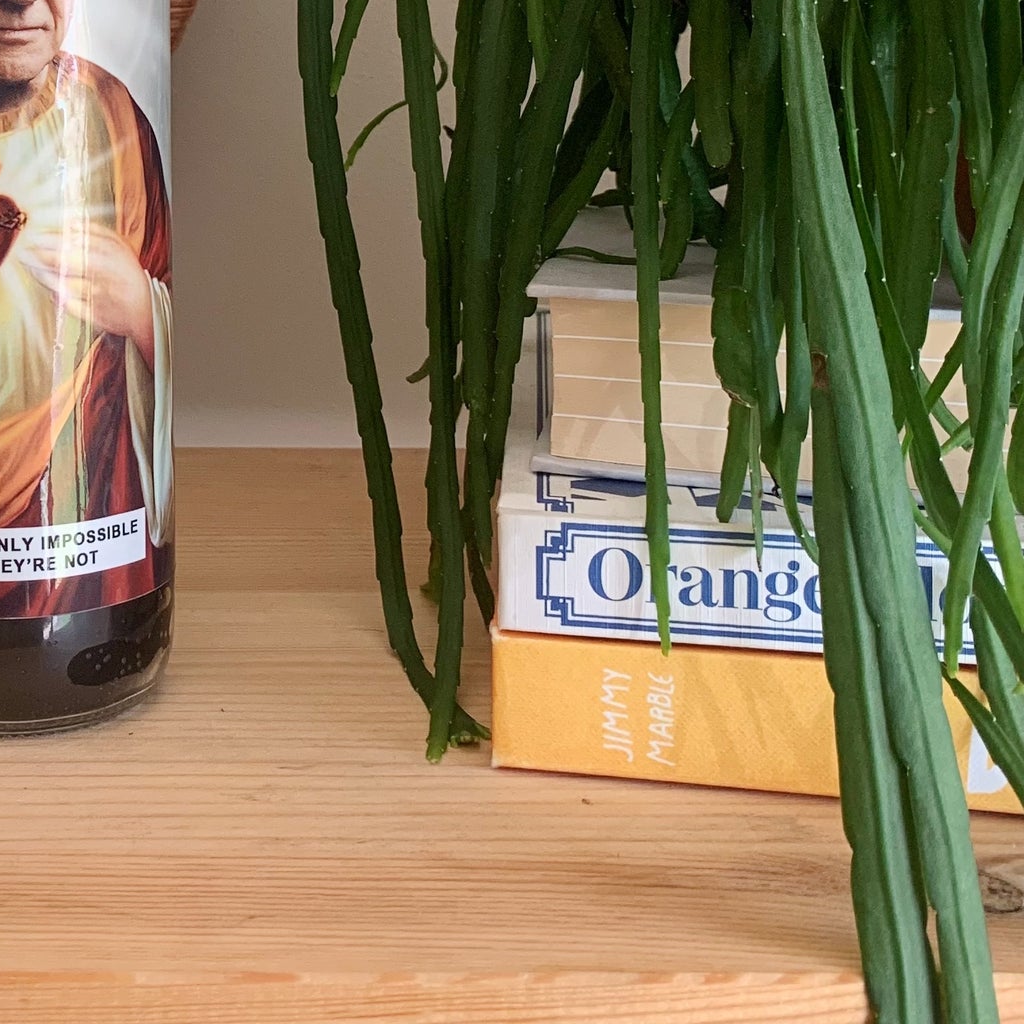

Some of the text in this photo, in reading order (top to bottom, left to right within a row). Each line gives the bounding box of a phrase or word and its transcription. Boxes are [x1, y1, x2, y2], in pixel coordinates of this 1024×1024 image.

[41, 519, 139, 551] IMPOSSIBLE
[64, 550, 99, 569] NOT
[600, 668, 634, 763] JIMMY
[646, 671, 677, 767] MARBLE
